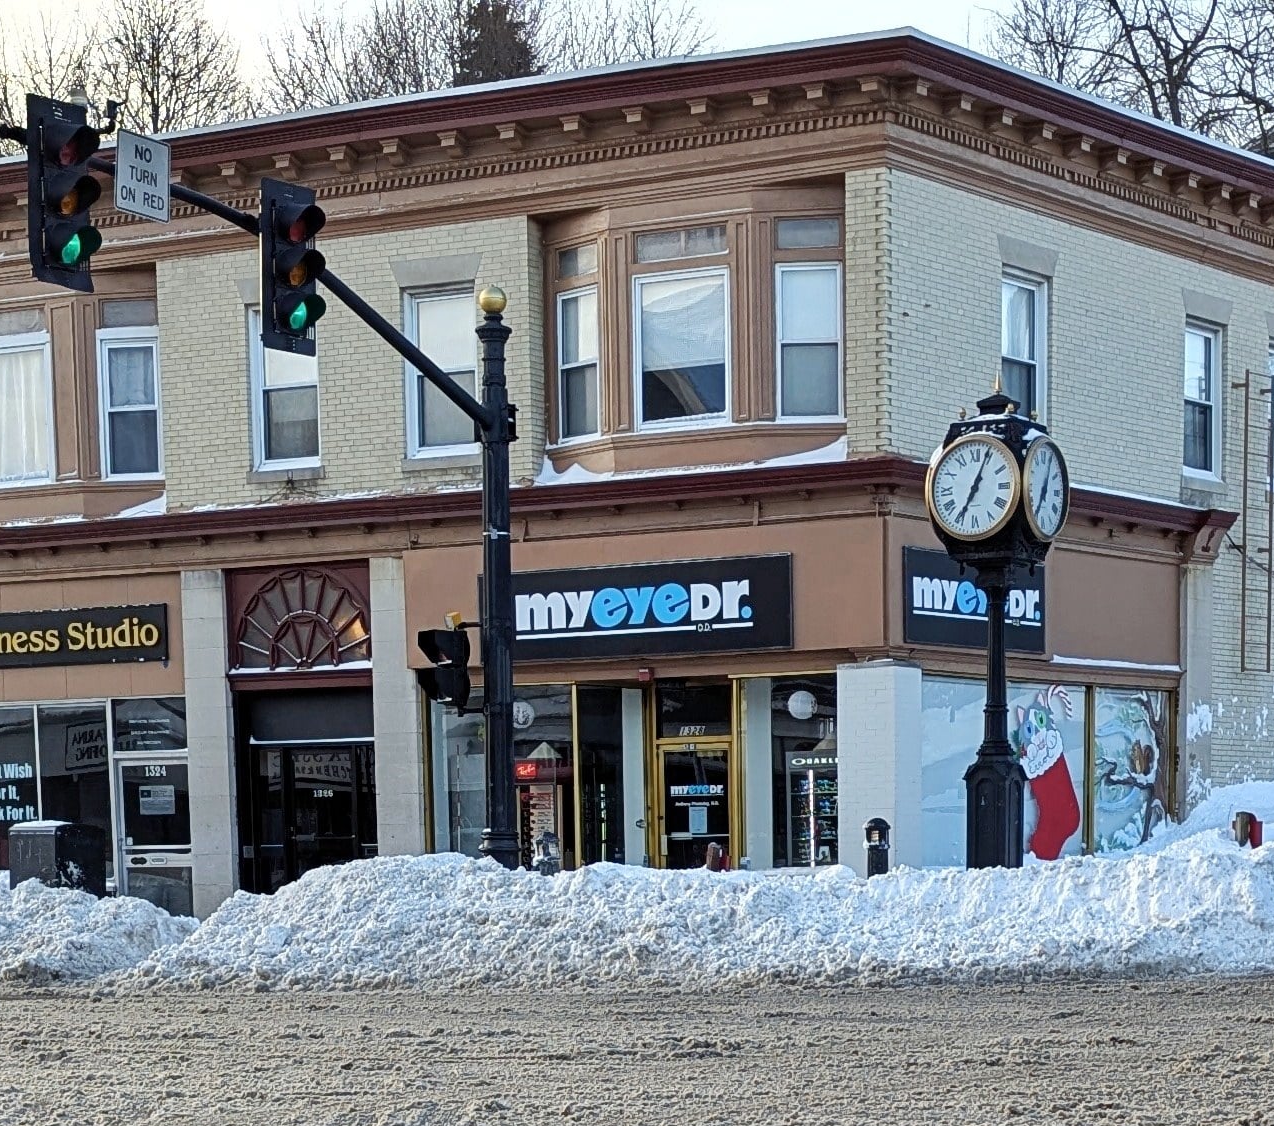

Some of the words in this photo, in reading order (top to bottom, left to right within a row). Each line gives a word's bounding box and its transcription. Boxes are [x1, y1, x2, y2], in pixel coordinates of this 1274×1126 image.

[134, 144, 152, 163] NO
[129, 164, 158, 188] TURN
[120, 185, 136, 204] ON
[143, 191, 165, 211] RED
[67, 617, 159, 651] Studio
[806, 757, 839, 765] OAKLE
[3, 763, 32, 778] Wish
[145, 766, 167, 777] 1324
[8, 785, 20, 800] It,
[6, 806, 24, 820] For
[25, 806, 37, 820] It.
